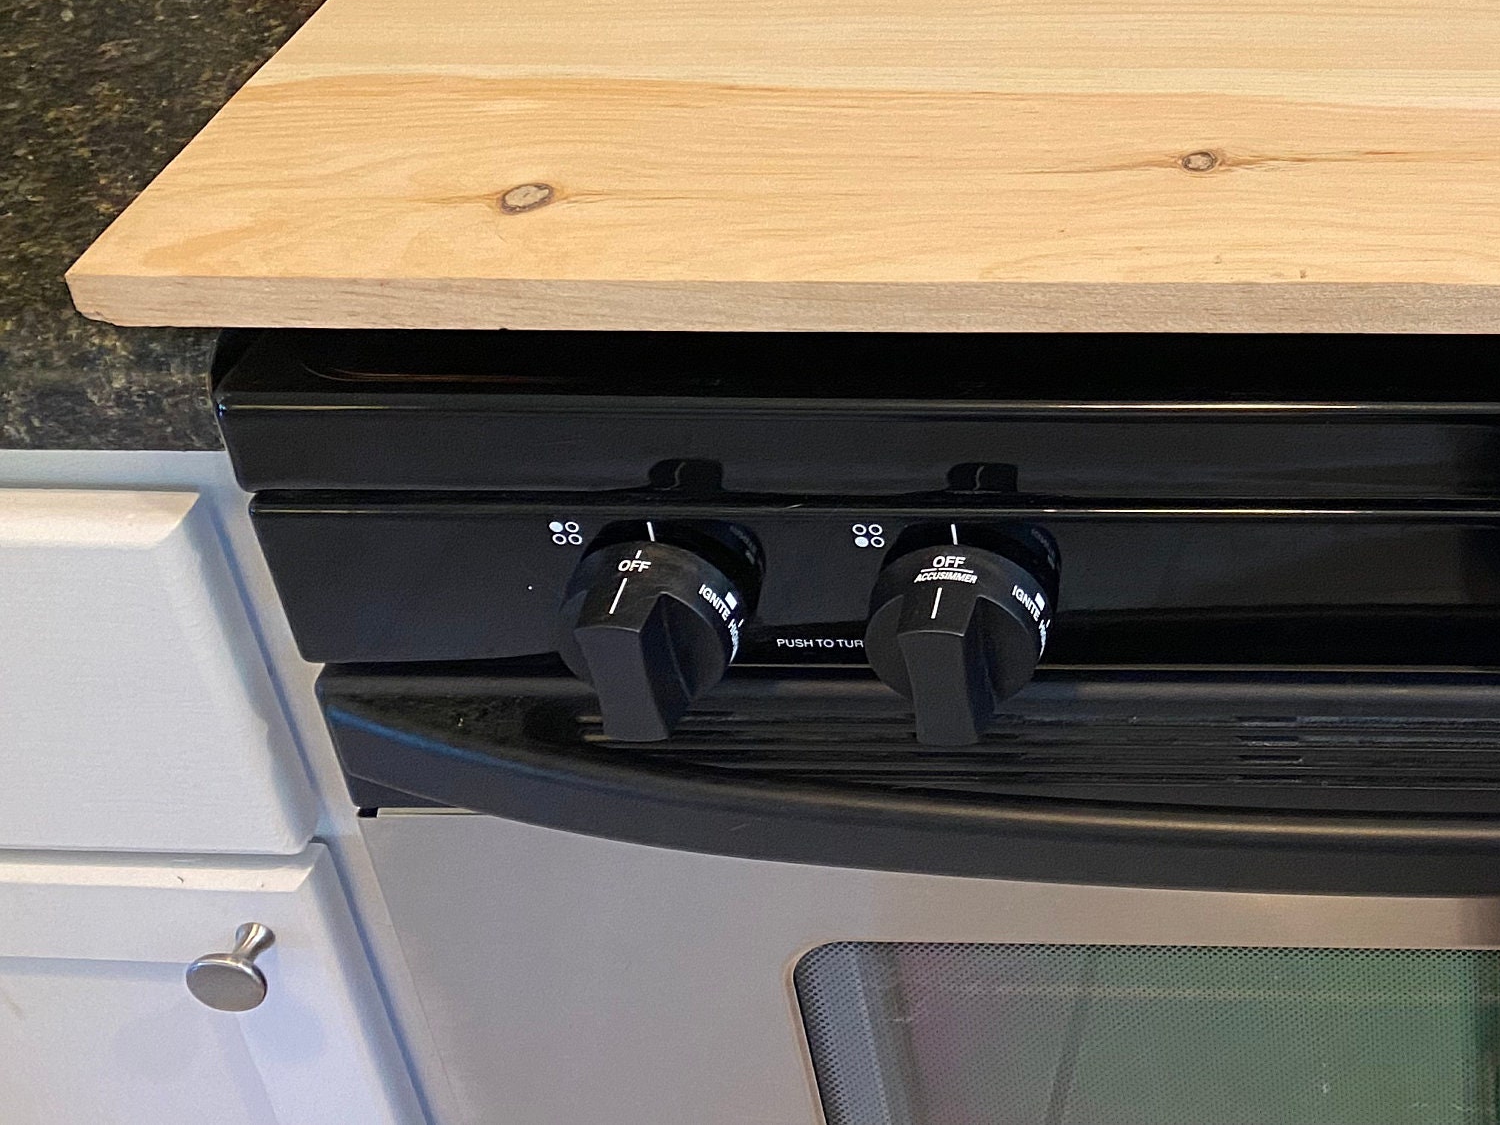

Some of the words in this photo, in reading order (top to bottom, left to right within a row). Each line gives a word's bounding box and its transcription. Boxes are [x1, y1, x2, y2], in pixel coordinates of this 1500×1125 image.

[618, 560, 651, 573] OFF
[933, 556, 965, 568] OFF
[914, 572, 977, 584] ACCUSIMMER
[698, 583, 731, 621] IGNITE
[1012, 585, 1040, 622] IGNITE
[777, 638, 813, 648] PUSH
[815, 638, 834, 648] TO
[836, 638, 864, 648] TUR
